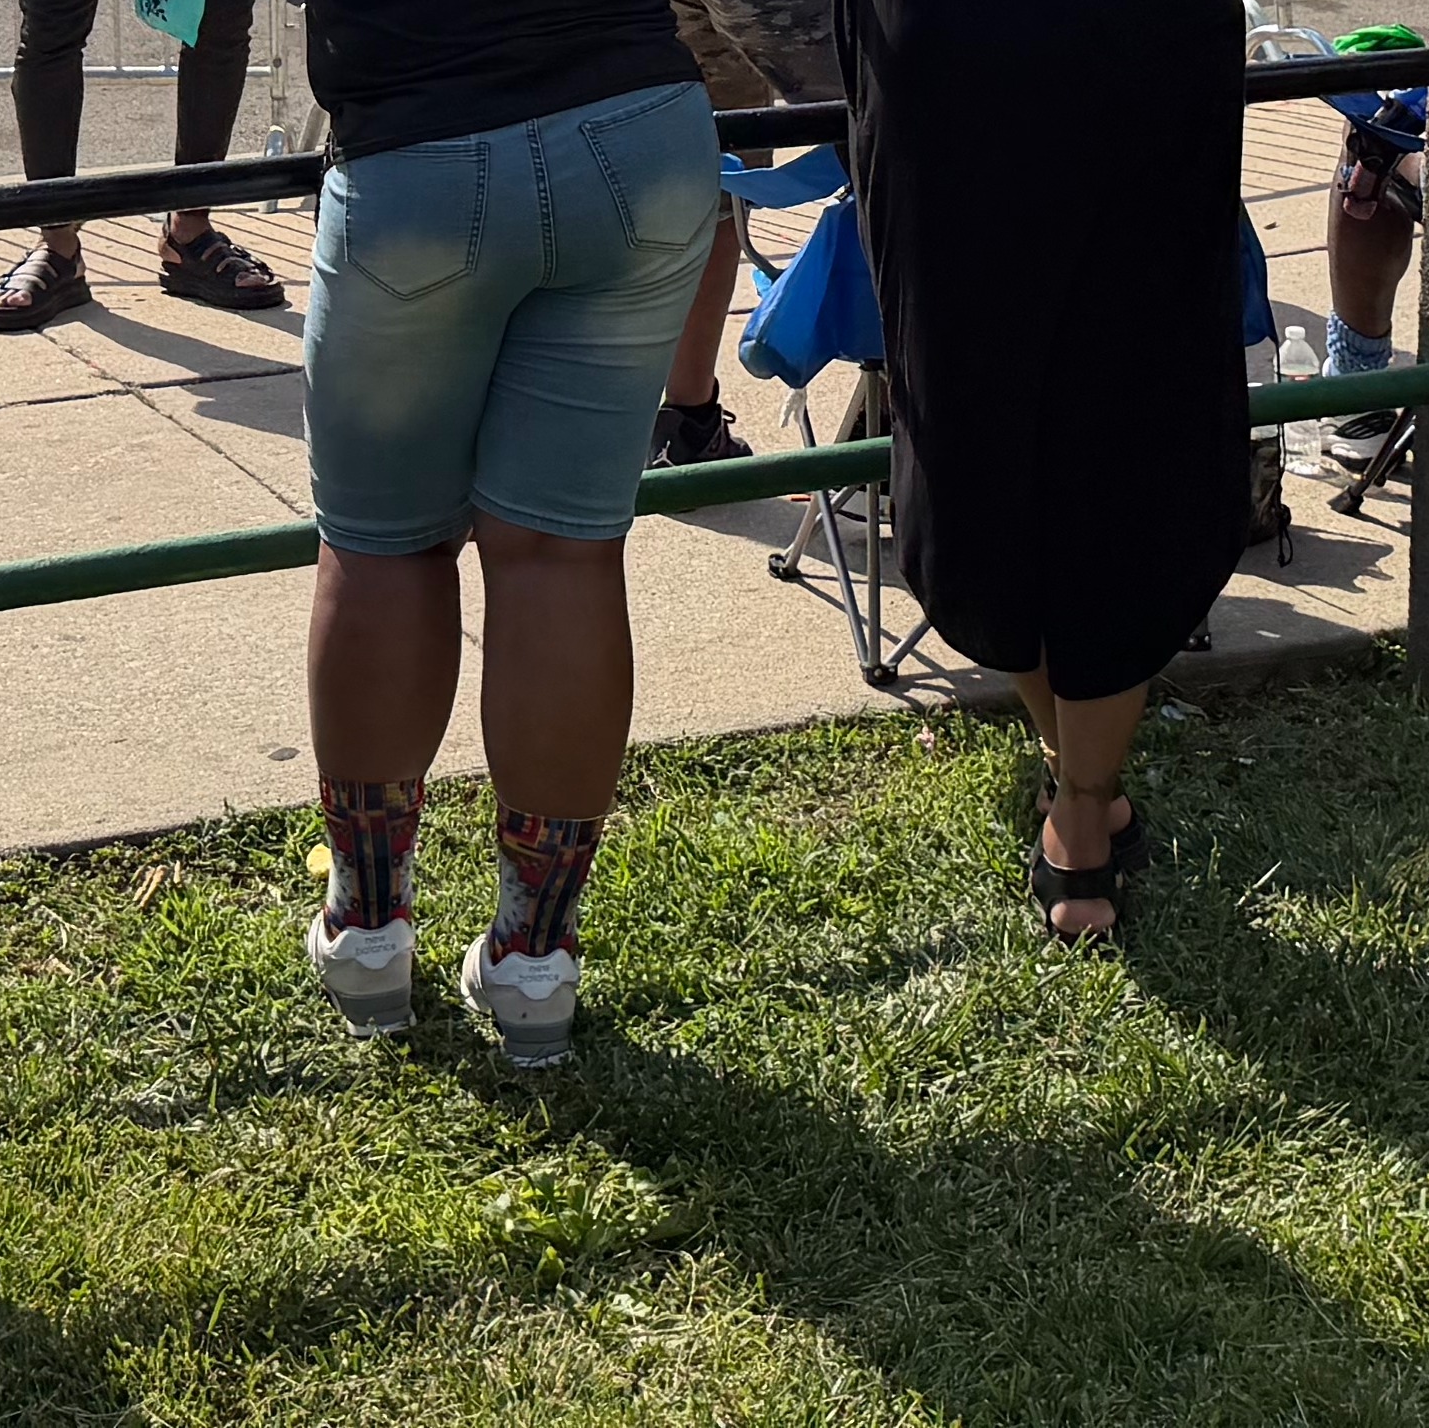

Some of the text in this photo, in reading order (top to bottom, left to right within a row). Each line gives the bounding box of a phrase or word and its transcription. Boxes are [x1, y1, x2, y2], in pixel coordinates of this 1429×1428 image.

[365, 935, 385, 943] new
[355, 943, 396, 956] balance
[529, 965, 550, 973] new
[519, 973, 559, 983] balance
